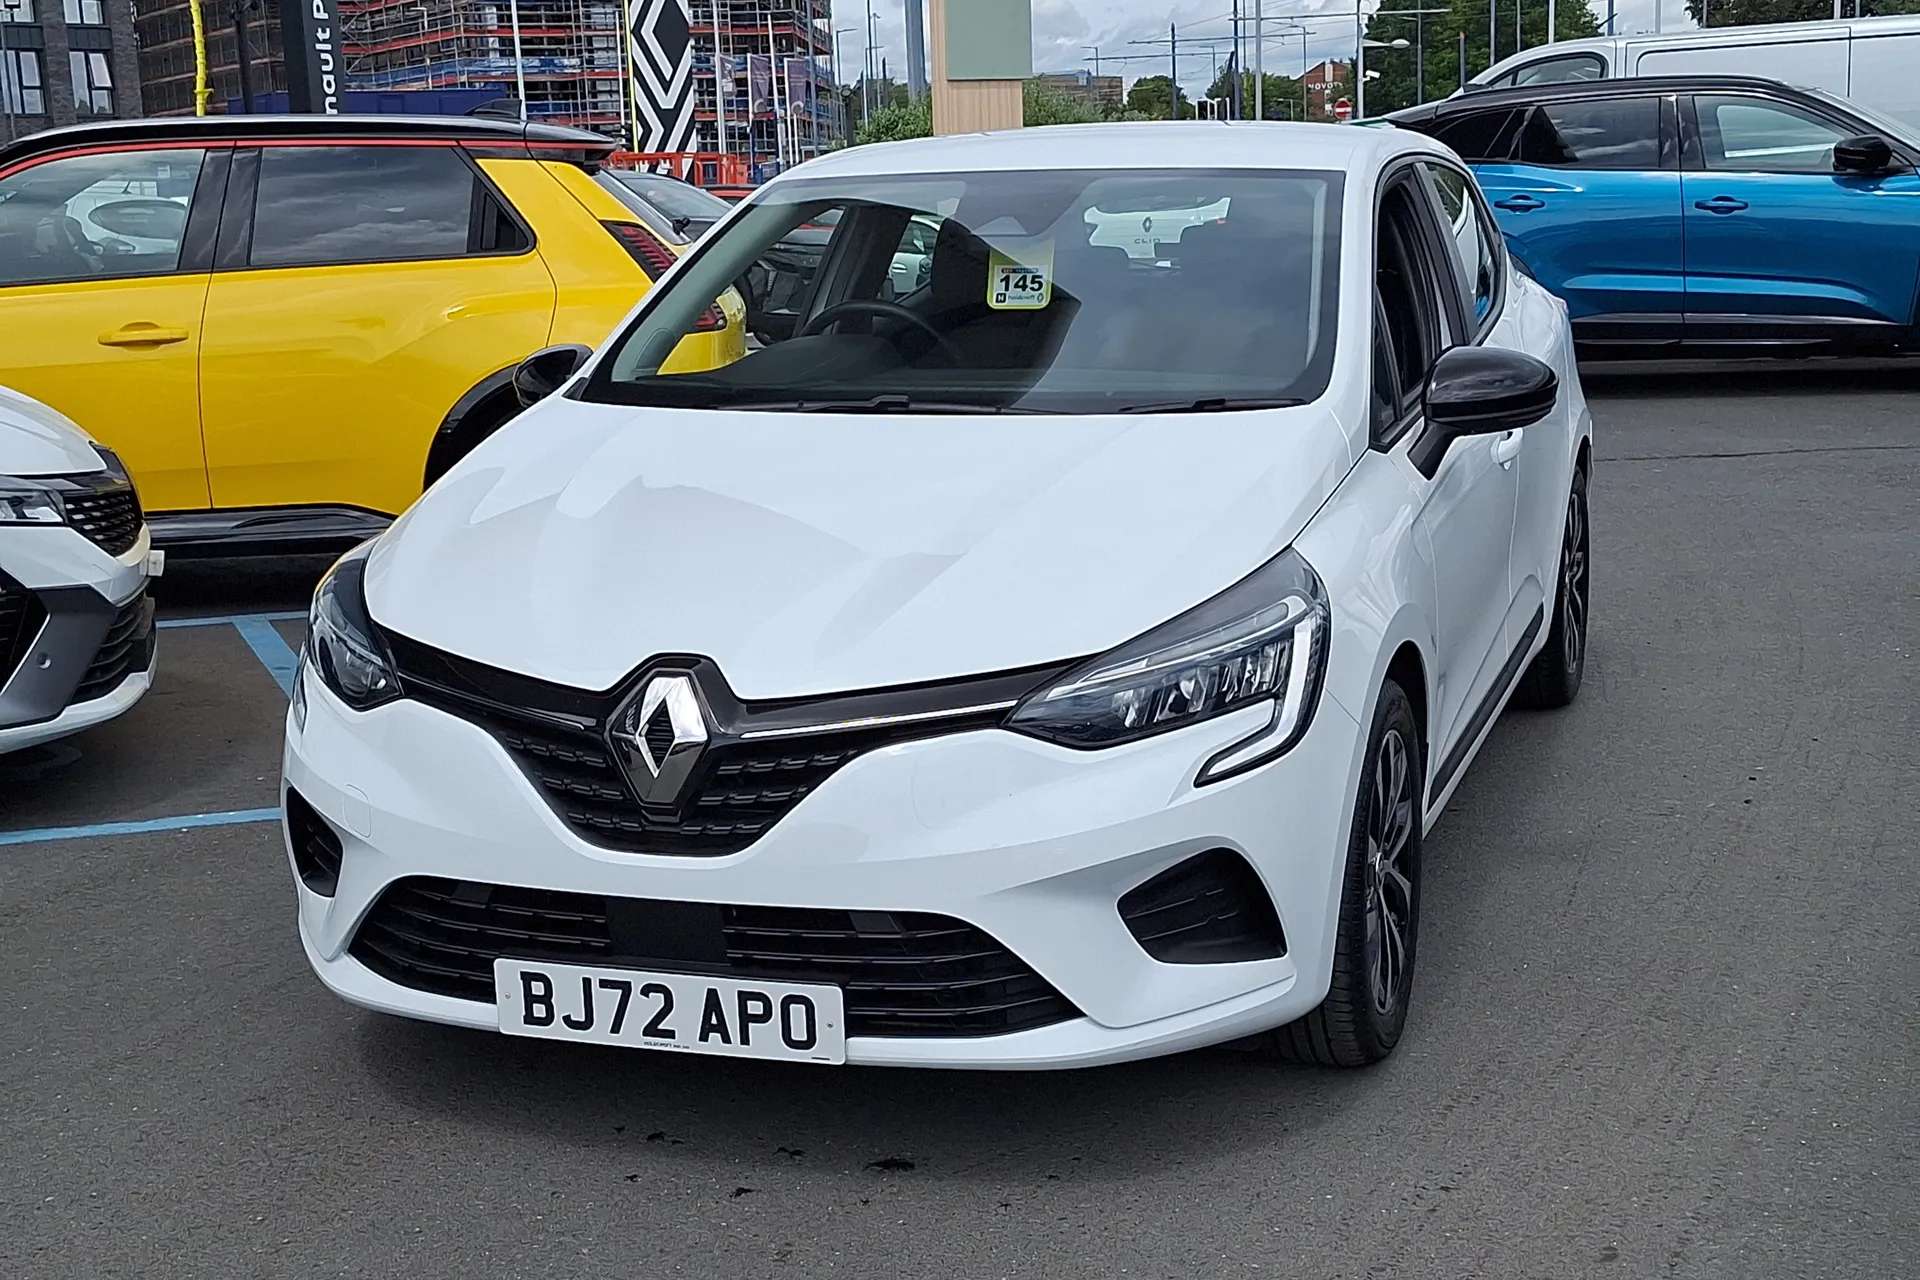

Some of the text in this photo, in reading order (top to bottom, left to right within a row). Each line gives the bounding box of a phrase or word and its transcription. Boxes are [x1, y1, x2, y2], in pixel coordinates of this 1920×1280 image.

[1000, 274, 1043, 292] 145
[519, 970, 818, 1050] BJ72 APO
